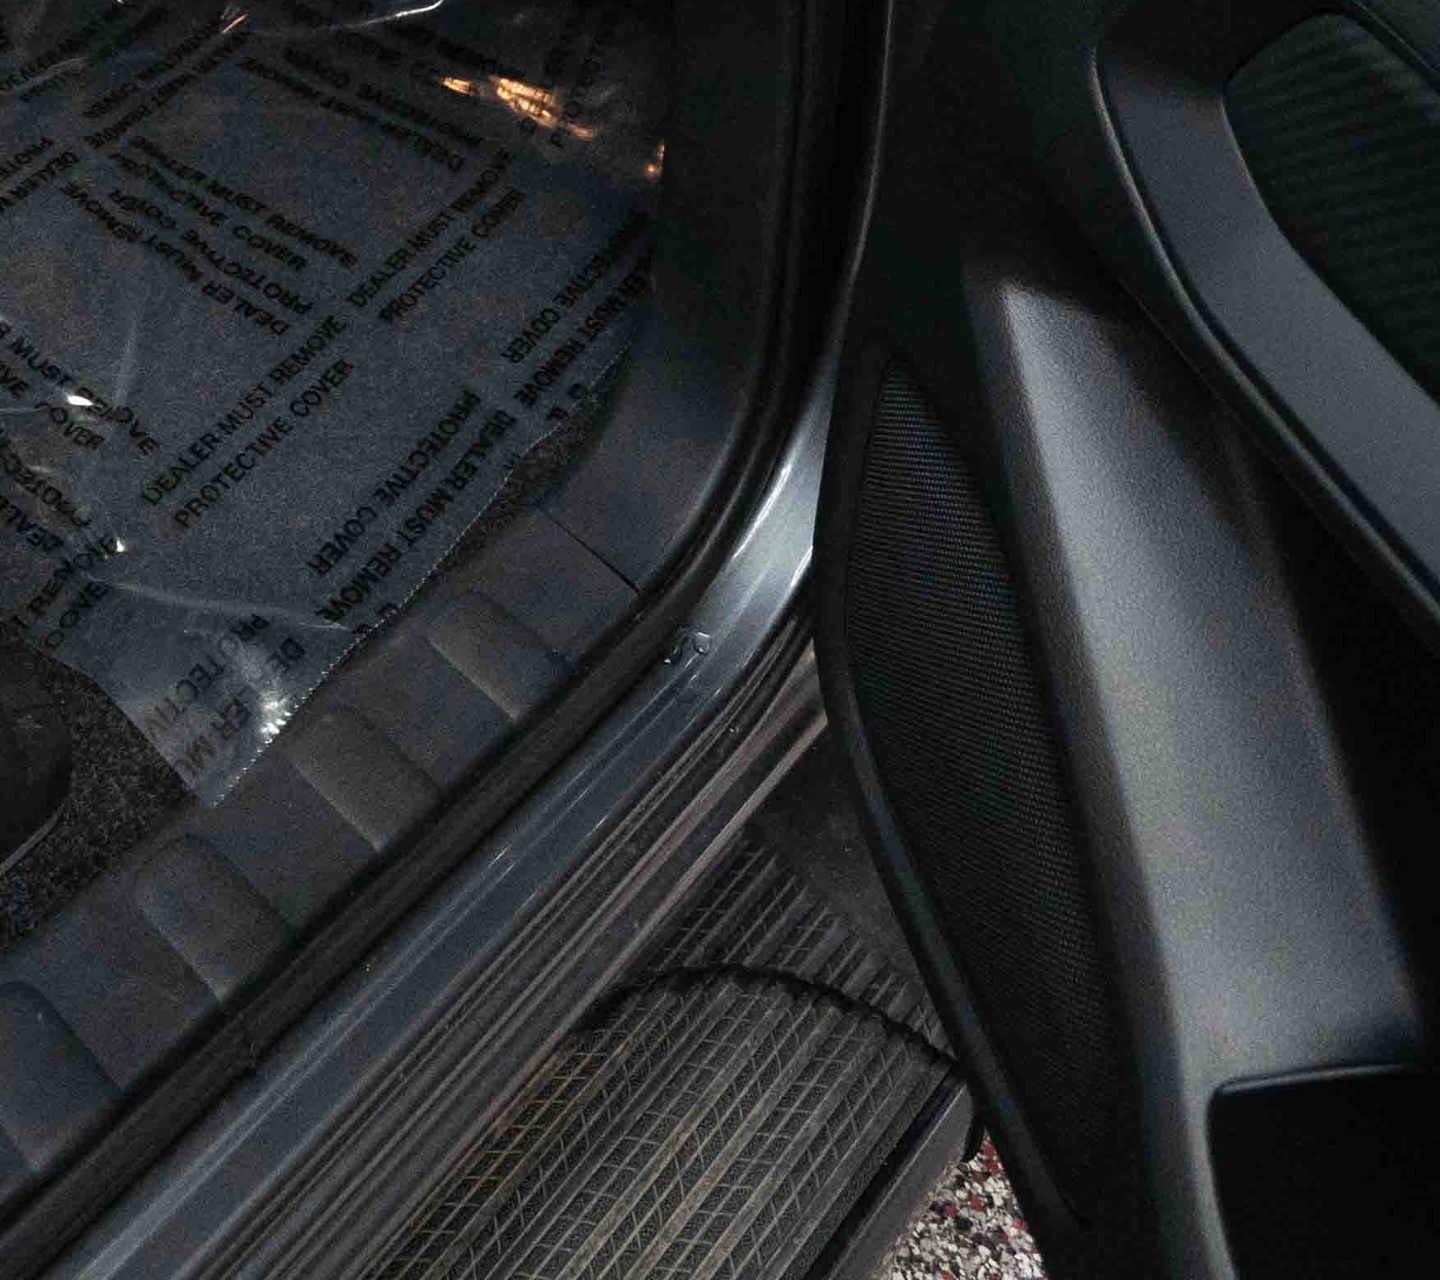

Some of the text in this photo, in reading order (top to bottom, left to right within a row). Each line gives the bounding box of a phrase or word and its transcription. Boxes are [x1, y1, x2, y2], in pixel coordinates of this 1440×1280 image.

[233, 225, 307, 271] COVER
[266, 212, 358, 267] REMOVE
[347, 245, 411, 309] DEALER
[405, 209, 454, 254] MUST
[379, 187, 526, 324] PROTECTIVE COVER
[202, 282, 290, 335] DEALER
[500, 306, 561, 365] COVER
[12, 337, 73, 388] MUST
[514, 337, 585, 407] REMOVE
[142, 314, 346, 506] DEALER MUST REMOVE
[173, 357, 354, 529] PROTECTIVE COVER
[306, 389, 481, 577] PROTECTIVE COVER
[315, 408, 518, 622] DEALER MUST REMOVE
